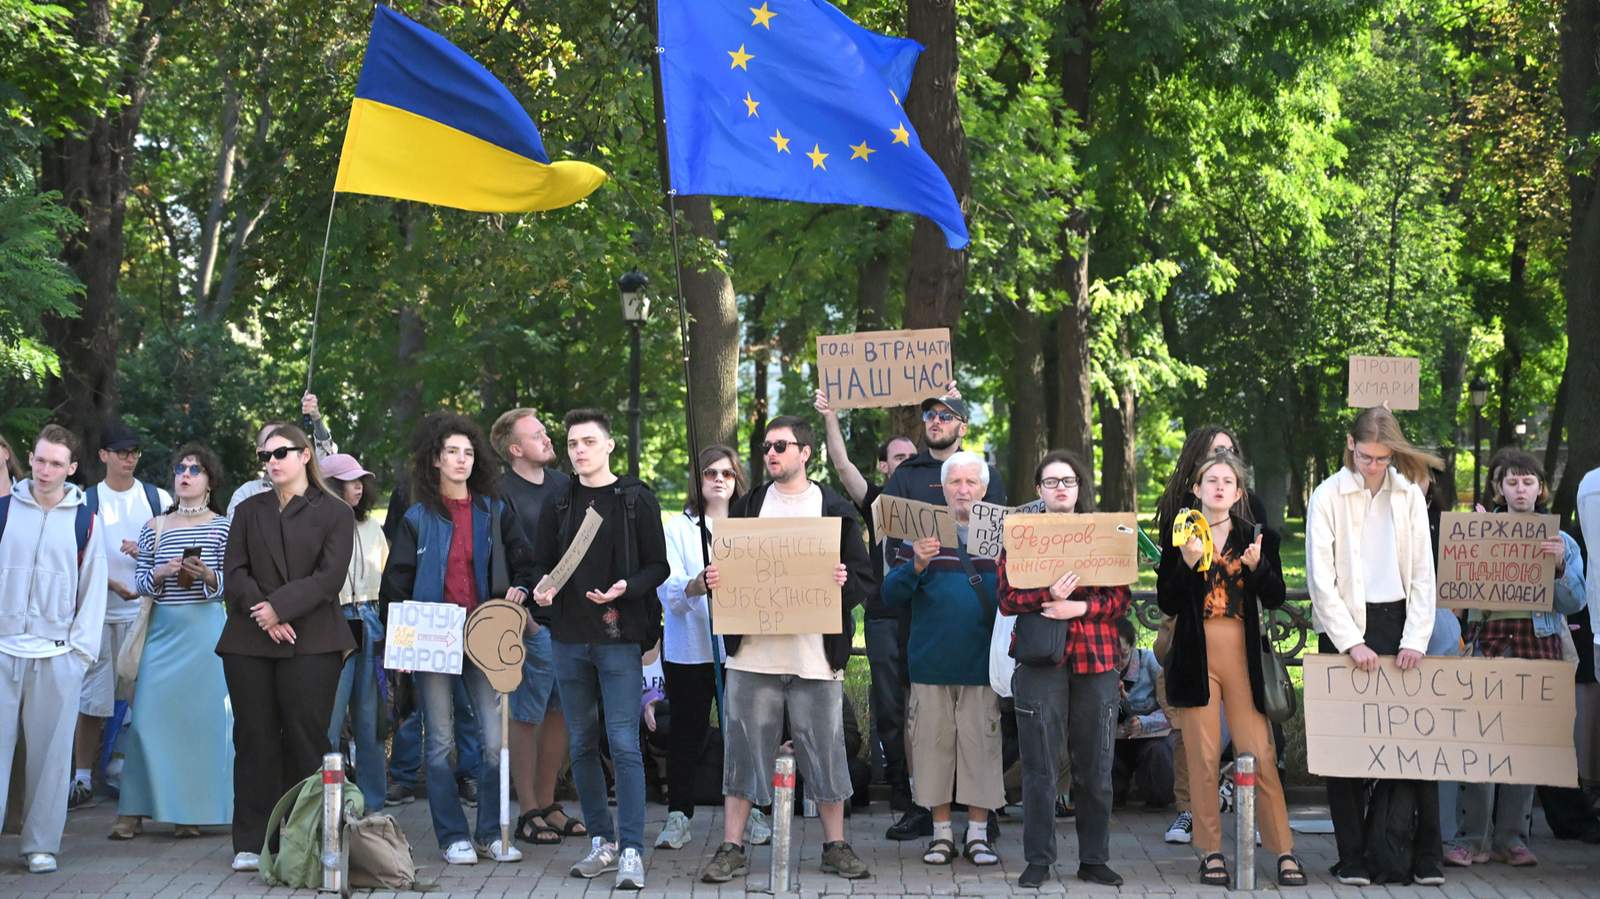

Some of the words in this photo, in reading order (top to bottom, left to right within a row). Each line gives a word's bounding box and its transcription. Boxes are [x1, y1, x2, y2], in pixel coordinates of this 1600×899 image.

[820, 342, 854, 357] ГОДІ
[864, 340, 950, 362] ВТРАЧАТИ
[824, 367, 892, 400] НАШ
[903, 358, 951, 392] ЧАС!
[1355, 359, 1413, 375] ПРОТИ
[1353, 380, 1414, 396] ХМАРИ
[1010, 522, 1096, 554] Федоров
[1449, 520, 1547, 540] ДЕРЖАВА
[1011, 556, 1065, 577] міністр
[1073, 548, 1131, 576] оборони
[1443, 543, 1479, 560] МАЄ
[1490, 542, 1546, 560] СТАТИ
[1455, 561, 1542, 584] ГІДНОЮ
[1439, 581, 1485, 600] СВОЇХ
[1489, 583, 1546, 603] ЛЮДЕЙ
[386, 645, 462, 673] НАРОД
[1326, 664, 1555, 701] ГОЛОСУЙТЕ
[1362, 702, 1505, 741] ПРОТИ
[1367, 744, 1513, 777] ХМАРИ
